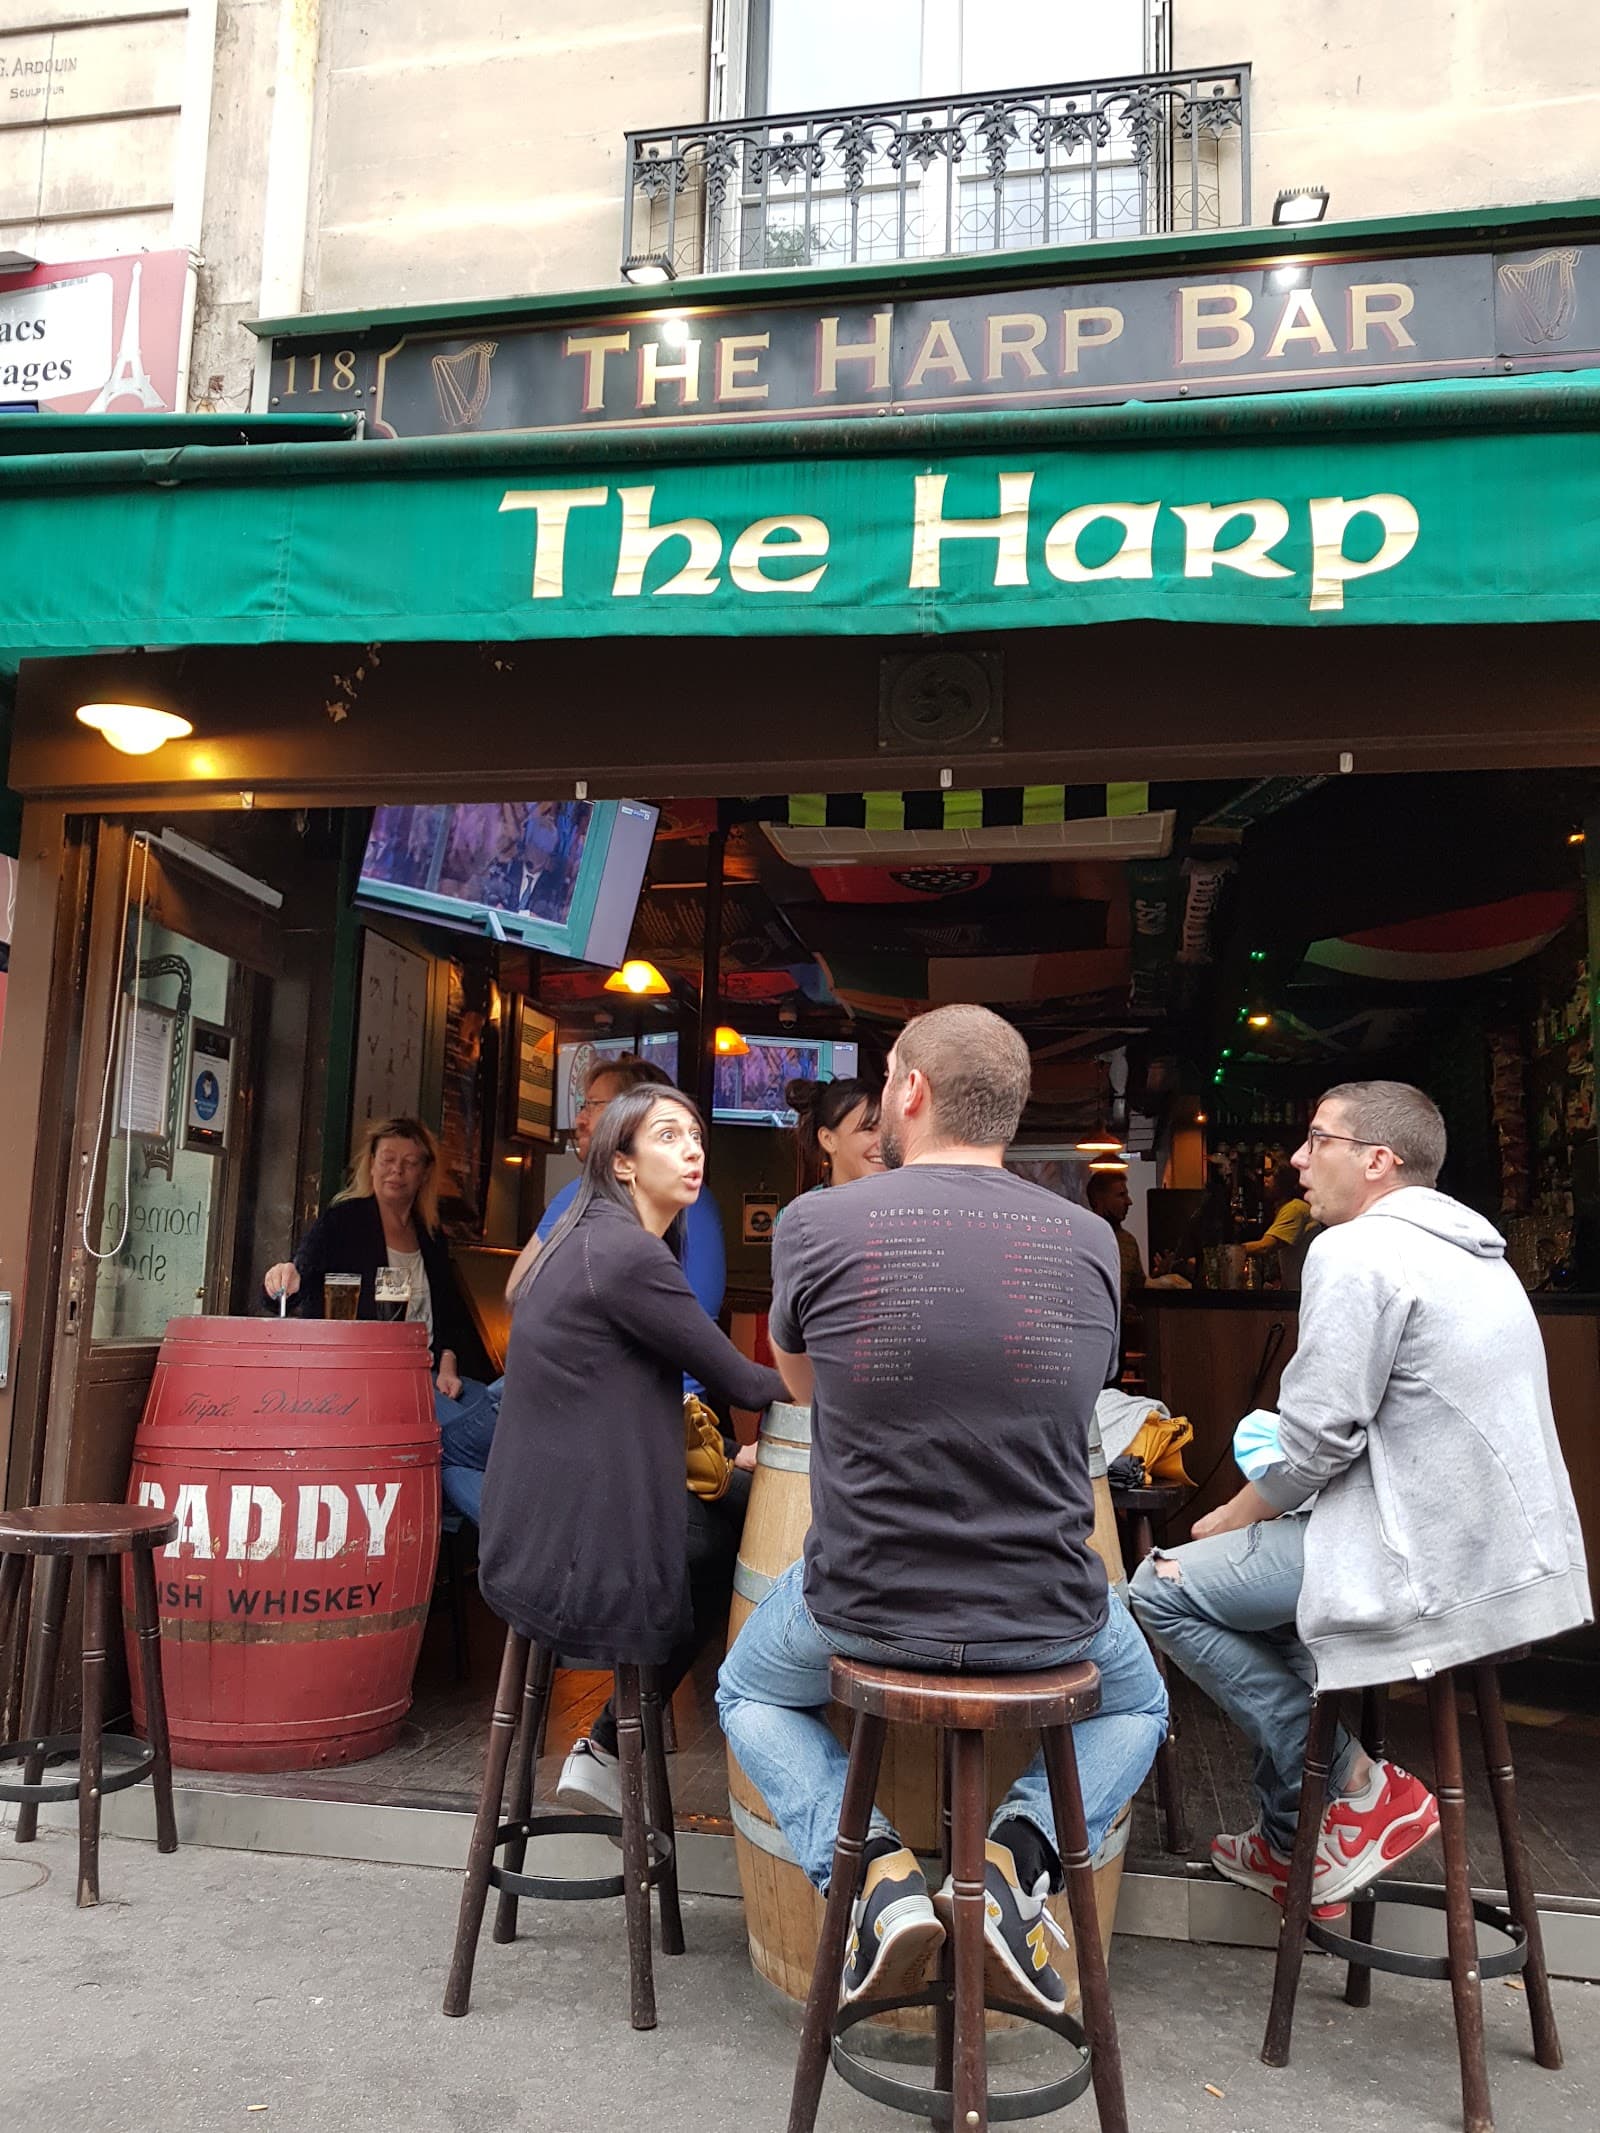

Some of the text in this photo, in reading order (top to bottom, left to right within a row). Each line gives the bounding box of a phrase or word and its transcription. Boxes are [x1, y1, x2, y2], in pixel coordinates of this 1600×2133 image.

[563, 282, 1418, 412] THE HARP BAR
[0, 358, 72, 392] ages
[283, 351, 355, 396] 118
[499, 484, 831, 599] The
[870, 1208, 1071, 1226] QUEENS OF THE STONE AGE
[227, 1582, 384, 1616] WHISKEY
